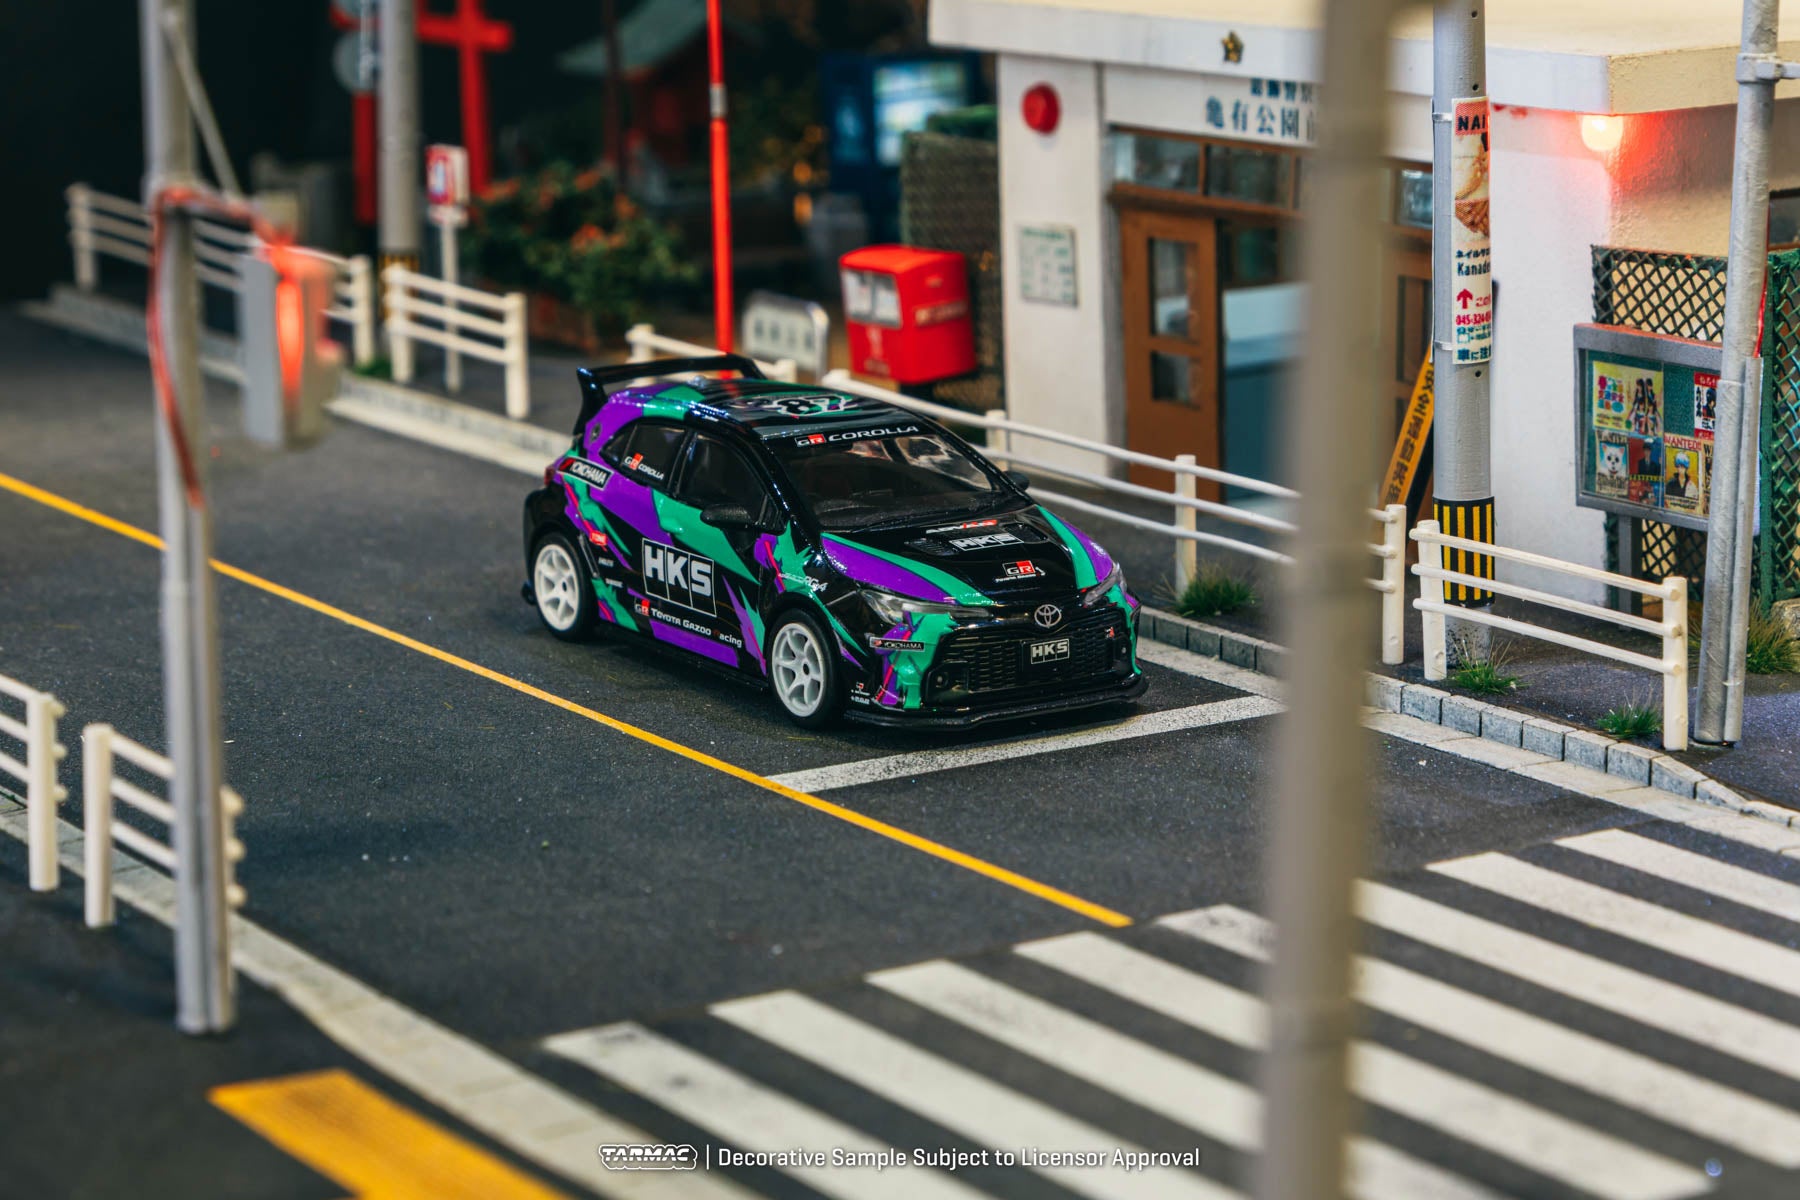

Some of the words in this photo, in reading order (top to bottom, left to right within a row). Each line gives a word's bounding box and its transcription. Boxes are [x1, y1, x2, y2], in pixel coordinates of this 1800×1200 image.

[796, 434, 825, 448] GR
[828, 425, 919, 442] COROLLA
[569, 461, 608, 485] YOKOHAMA
[624, 454, 644, 471] GR
[638, 463, 665, 481] COROLLA
[644, 544, 713, 597] HKS
[1005, 562, 1036, 576] GR
[884, 641, 922, 649] YOKOHAMA
[1031, 641, 1068, 658] HKS
